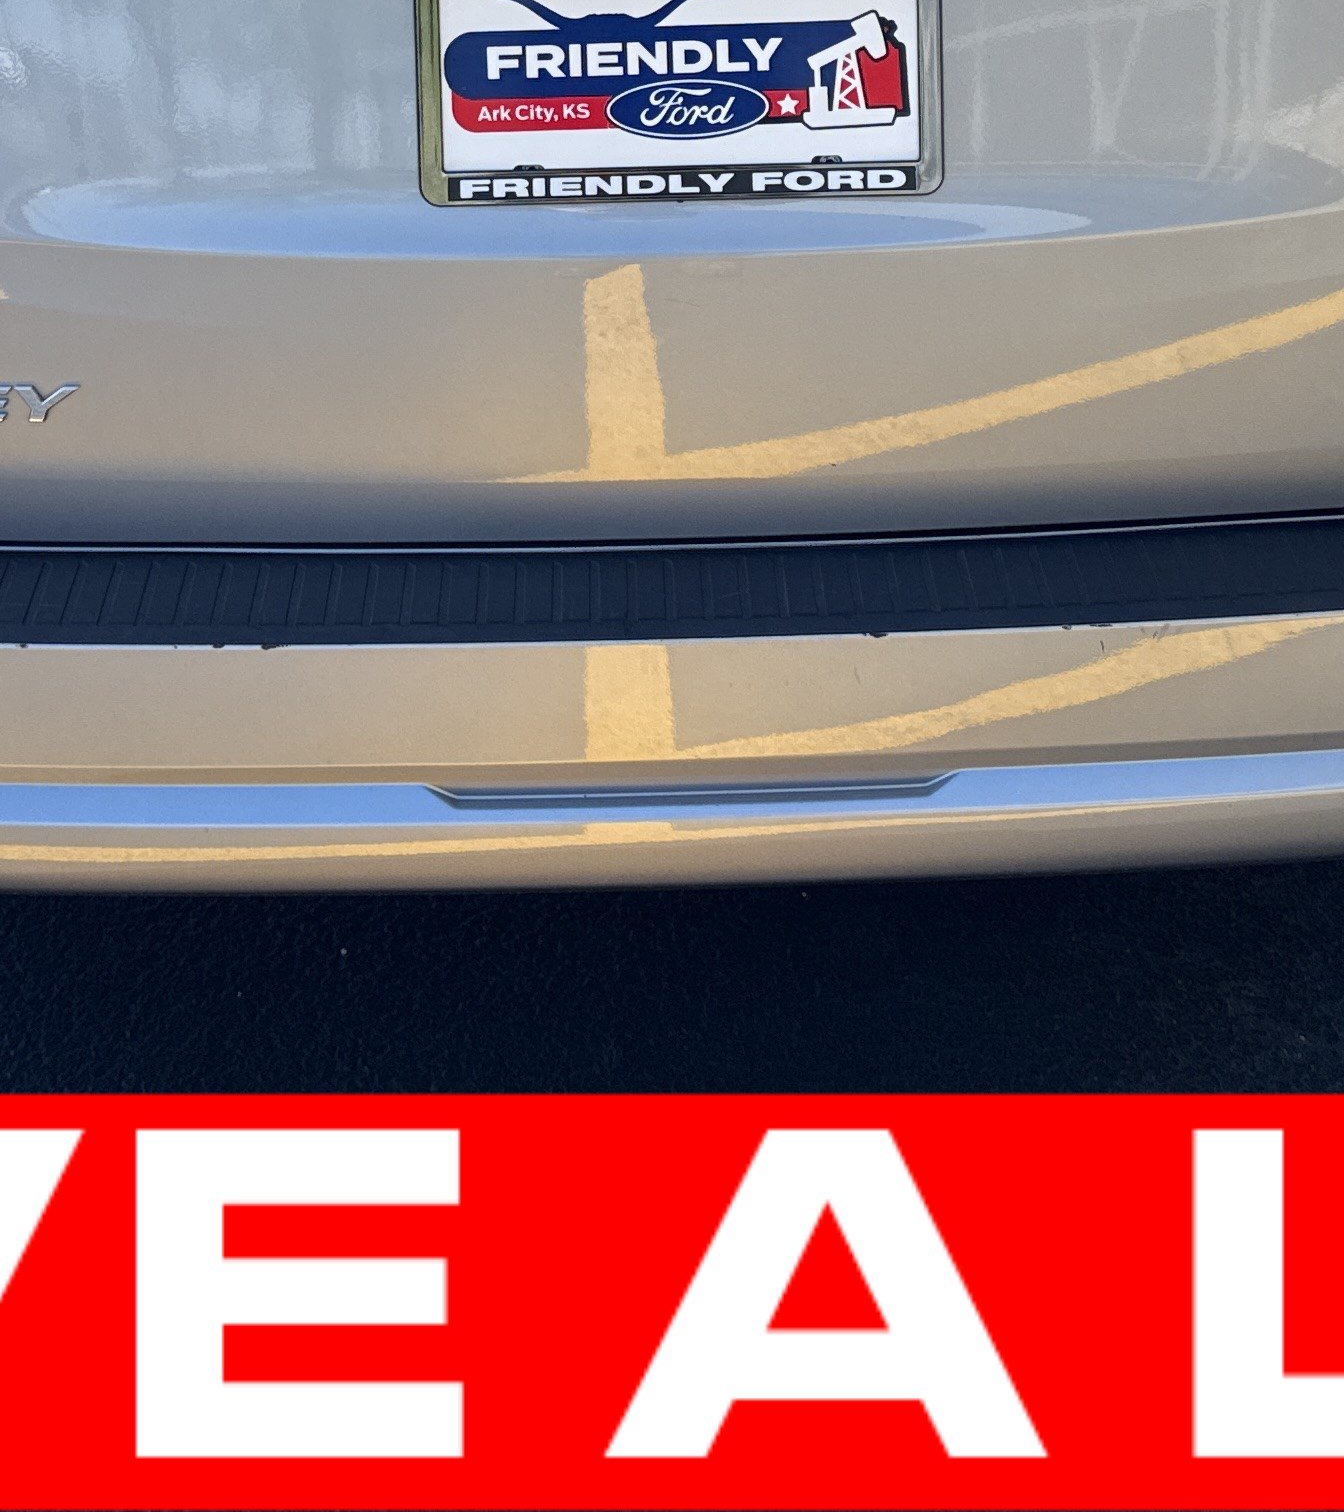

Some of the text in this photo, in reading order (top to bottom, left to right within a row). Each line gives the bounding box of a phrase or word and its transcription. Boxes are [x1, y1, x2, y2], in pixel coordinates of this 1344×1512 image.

[486, 36, 783, 80] FRIENDLY
[477, 103, 591, 123] Ark City, KS
[639, 87, 736, 127] Ford
[459, 169, 907, 199] FRIENDLY FORD
